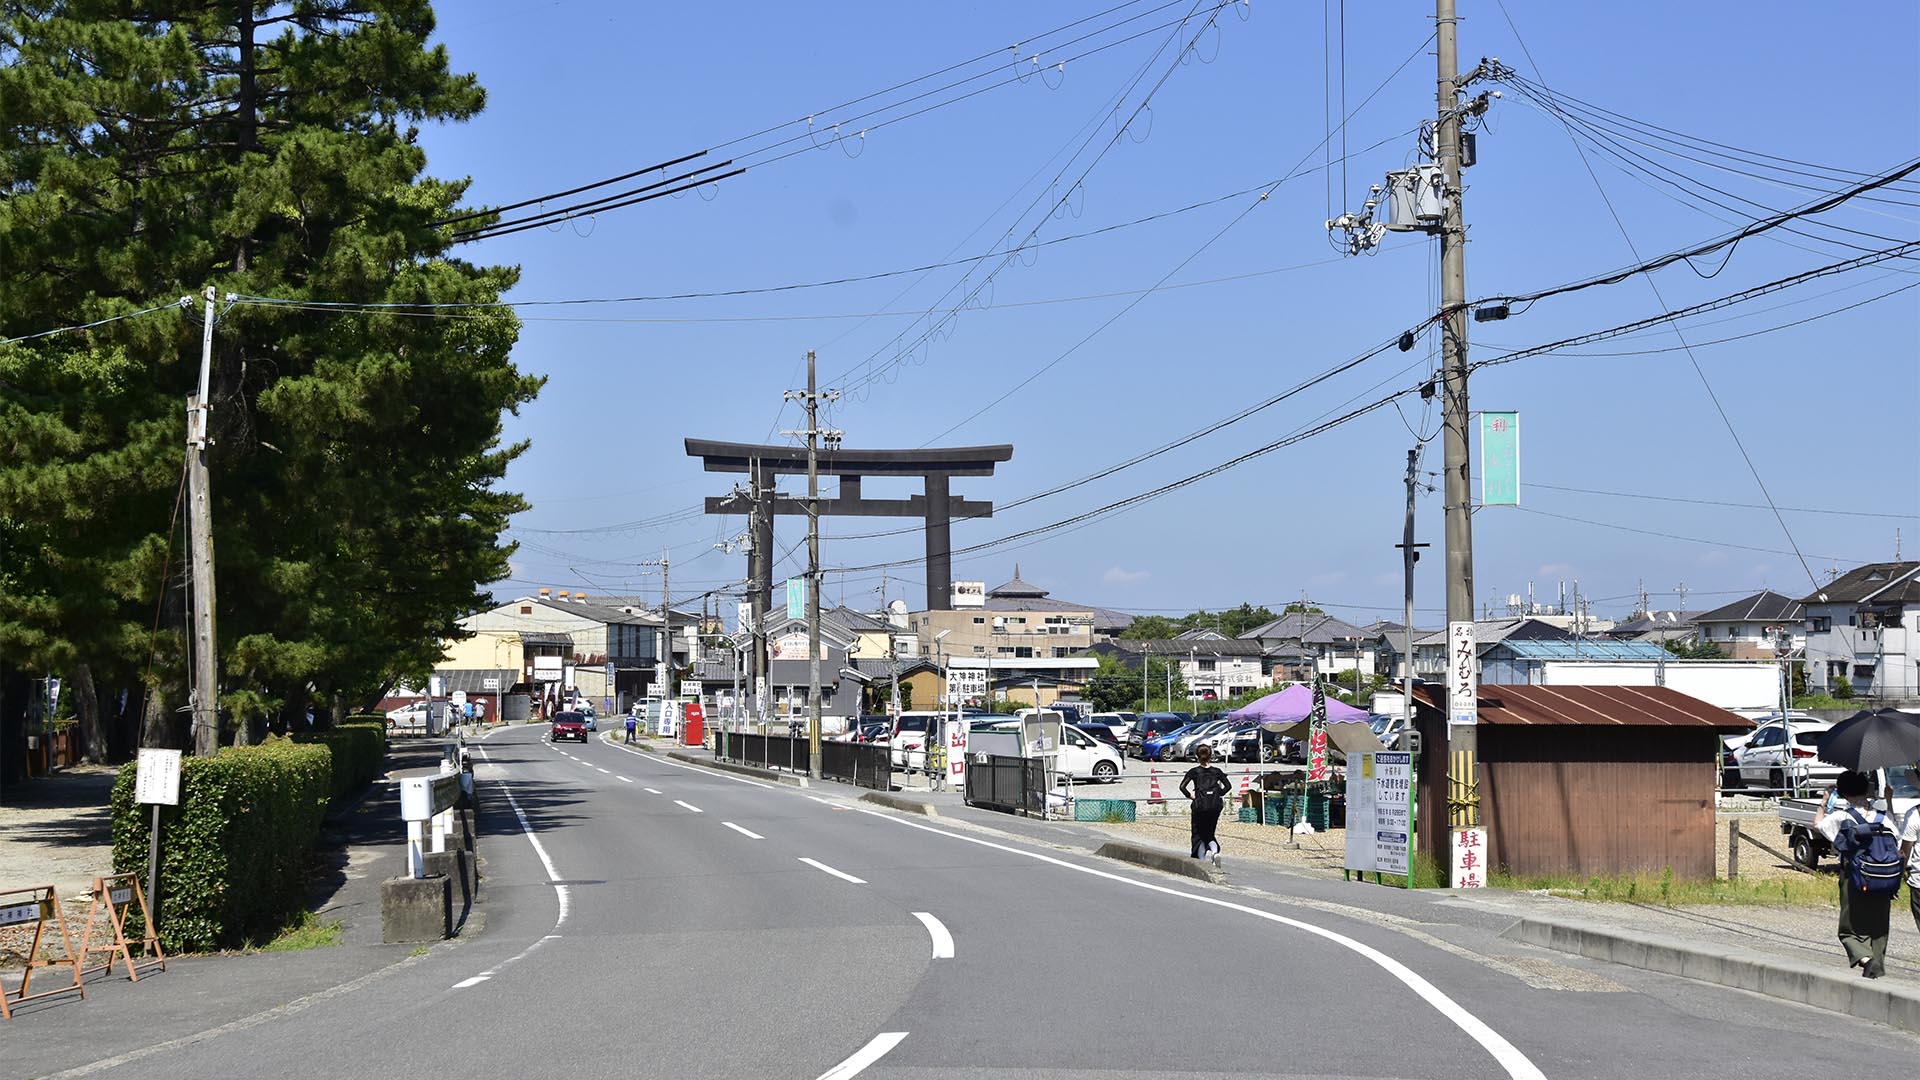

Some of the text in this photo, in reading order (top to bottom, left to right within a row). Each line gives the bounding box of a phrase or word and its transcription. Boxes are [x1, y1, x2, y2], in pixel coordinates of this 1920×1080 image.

[949, 671, 985, 681] 大神神社
[1456, 640, 1473, 698] みむろ
[948, 683, 985, 694] 第駐車場
[662, 701, 673, 734] 入口専用
[950, 732, 967, 775] 出口
[1378, 791, 1406, 802] しています
[1458, 830, 1481, 889] 駐車場
